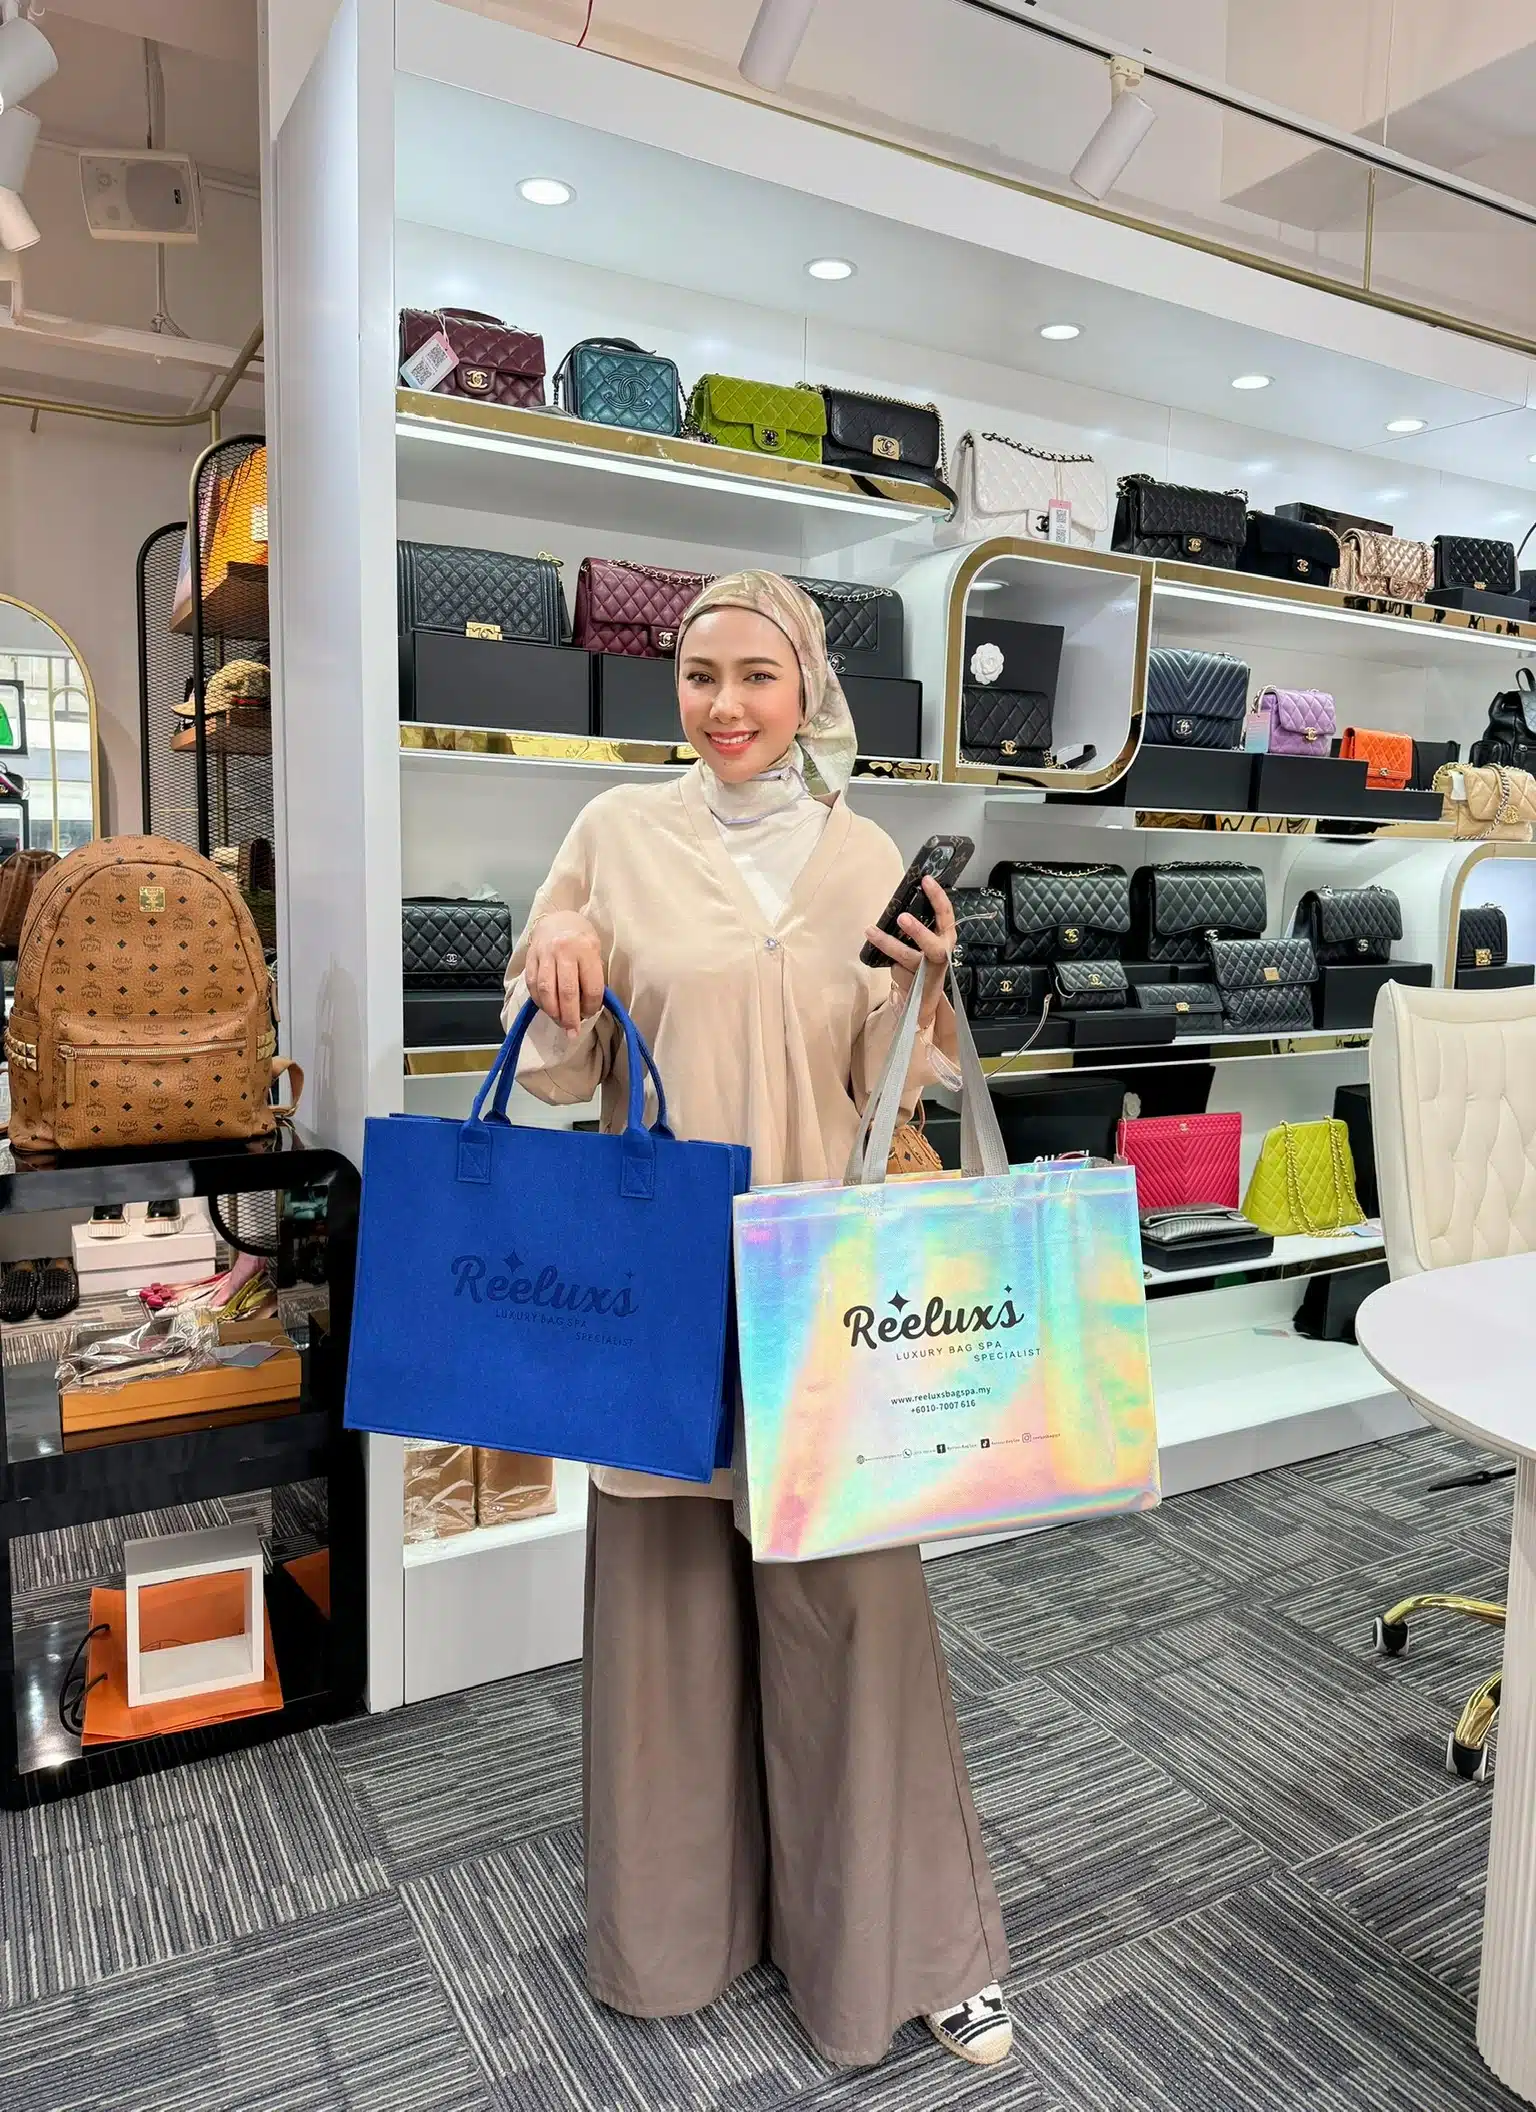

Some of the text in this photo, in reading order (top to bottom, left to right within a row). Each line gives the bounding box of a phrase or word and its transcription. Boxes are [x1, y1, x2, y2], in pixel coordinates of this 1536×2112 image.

[451, 1255, 639, 1317] Reeluxs
[496, 1307, 588, 1328] LUXURY BAG SPA
[843, 1297, 1025, 1350] Reeluxs
[576, 1332, 634, 1347] SPECIALIST
[896, 1340, 1002, 1361] LUXURY BAG SPA
[973, 1347, 1041, 1362] SPECIALIST
[890, 1386, 991, 1405] www.reeluxsbagspa.my
